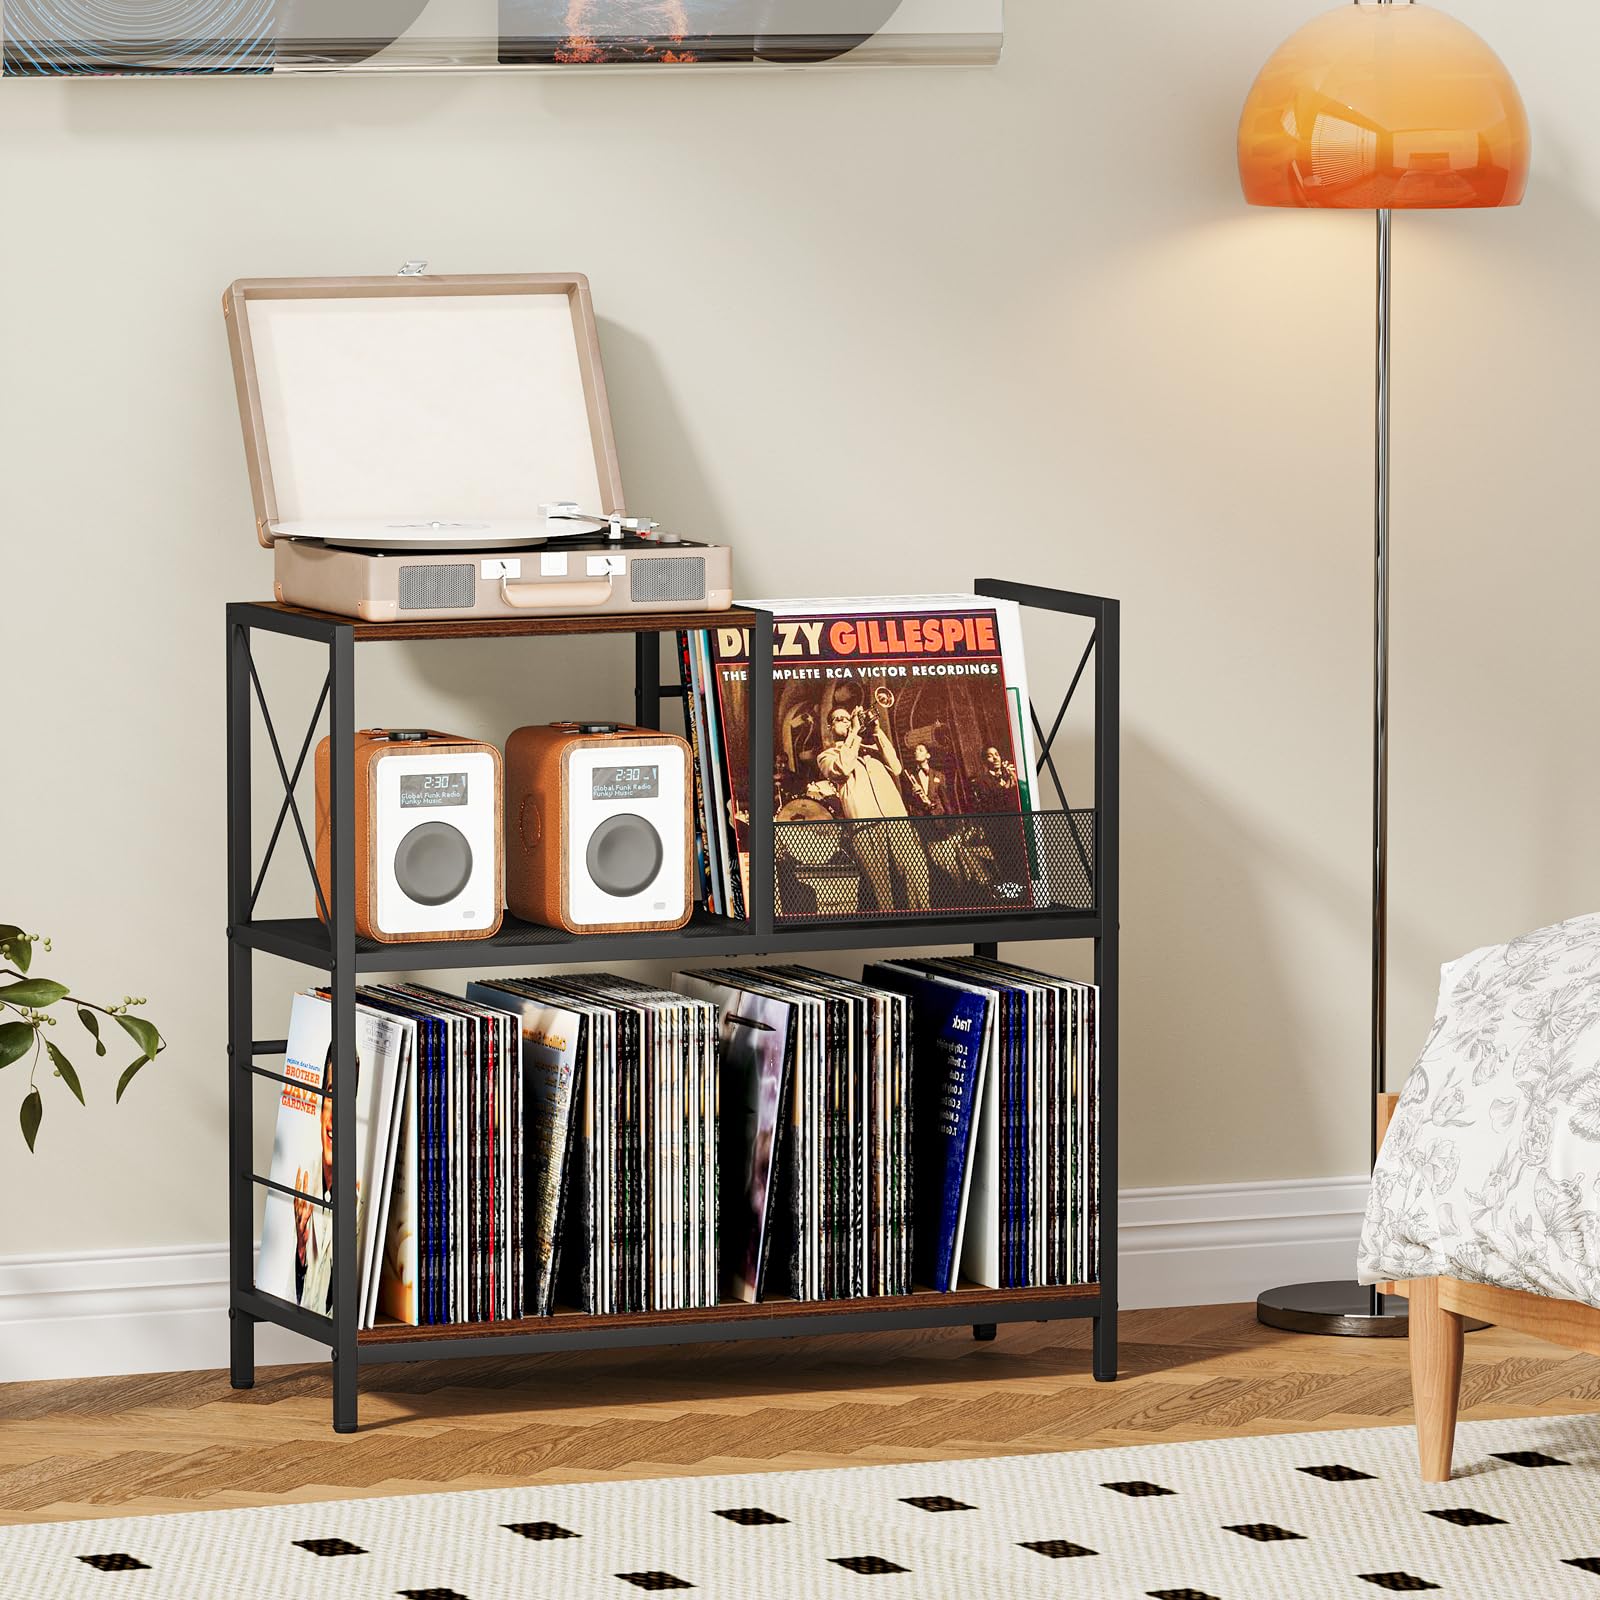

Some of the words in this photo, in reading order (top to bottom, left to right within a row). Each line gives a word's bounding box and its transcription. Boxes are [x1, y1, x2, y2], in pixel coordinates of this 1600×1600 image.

[829, 618, 997, 655] GILLESPIE
[722, 670, 748, 681] THE
[772, 668, 821, 680] MPLETE
[826, 667, 852, 679] RCA
[857, 666, 907, 678] VICTOR
[912, 663, 999, 676] RECORDINGS
[616, 768, 640, 781] 2:30
[424, 776, 449, 789] 2:30
[593, 784, 615, 792] Global
[442, 790, 461, 798] Radio
[286, 1065, 320, 1084] BROTHER
[282, 1096, 316, 1115] GARDNER
